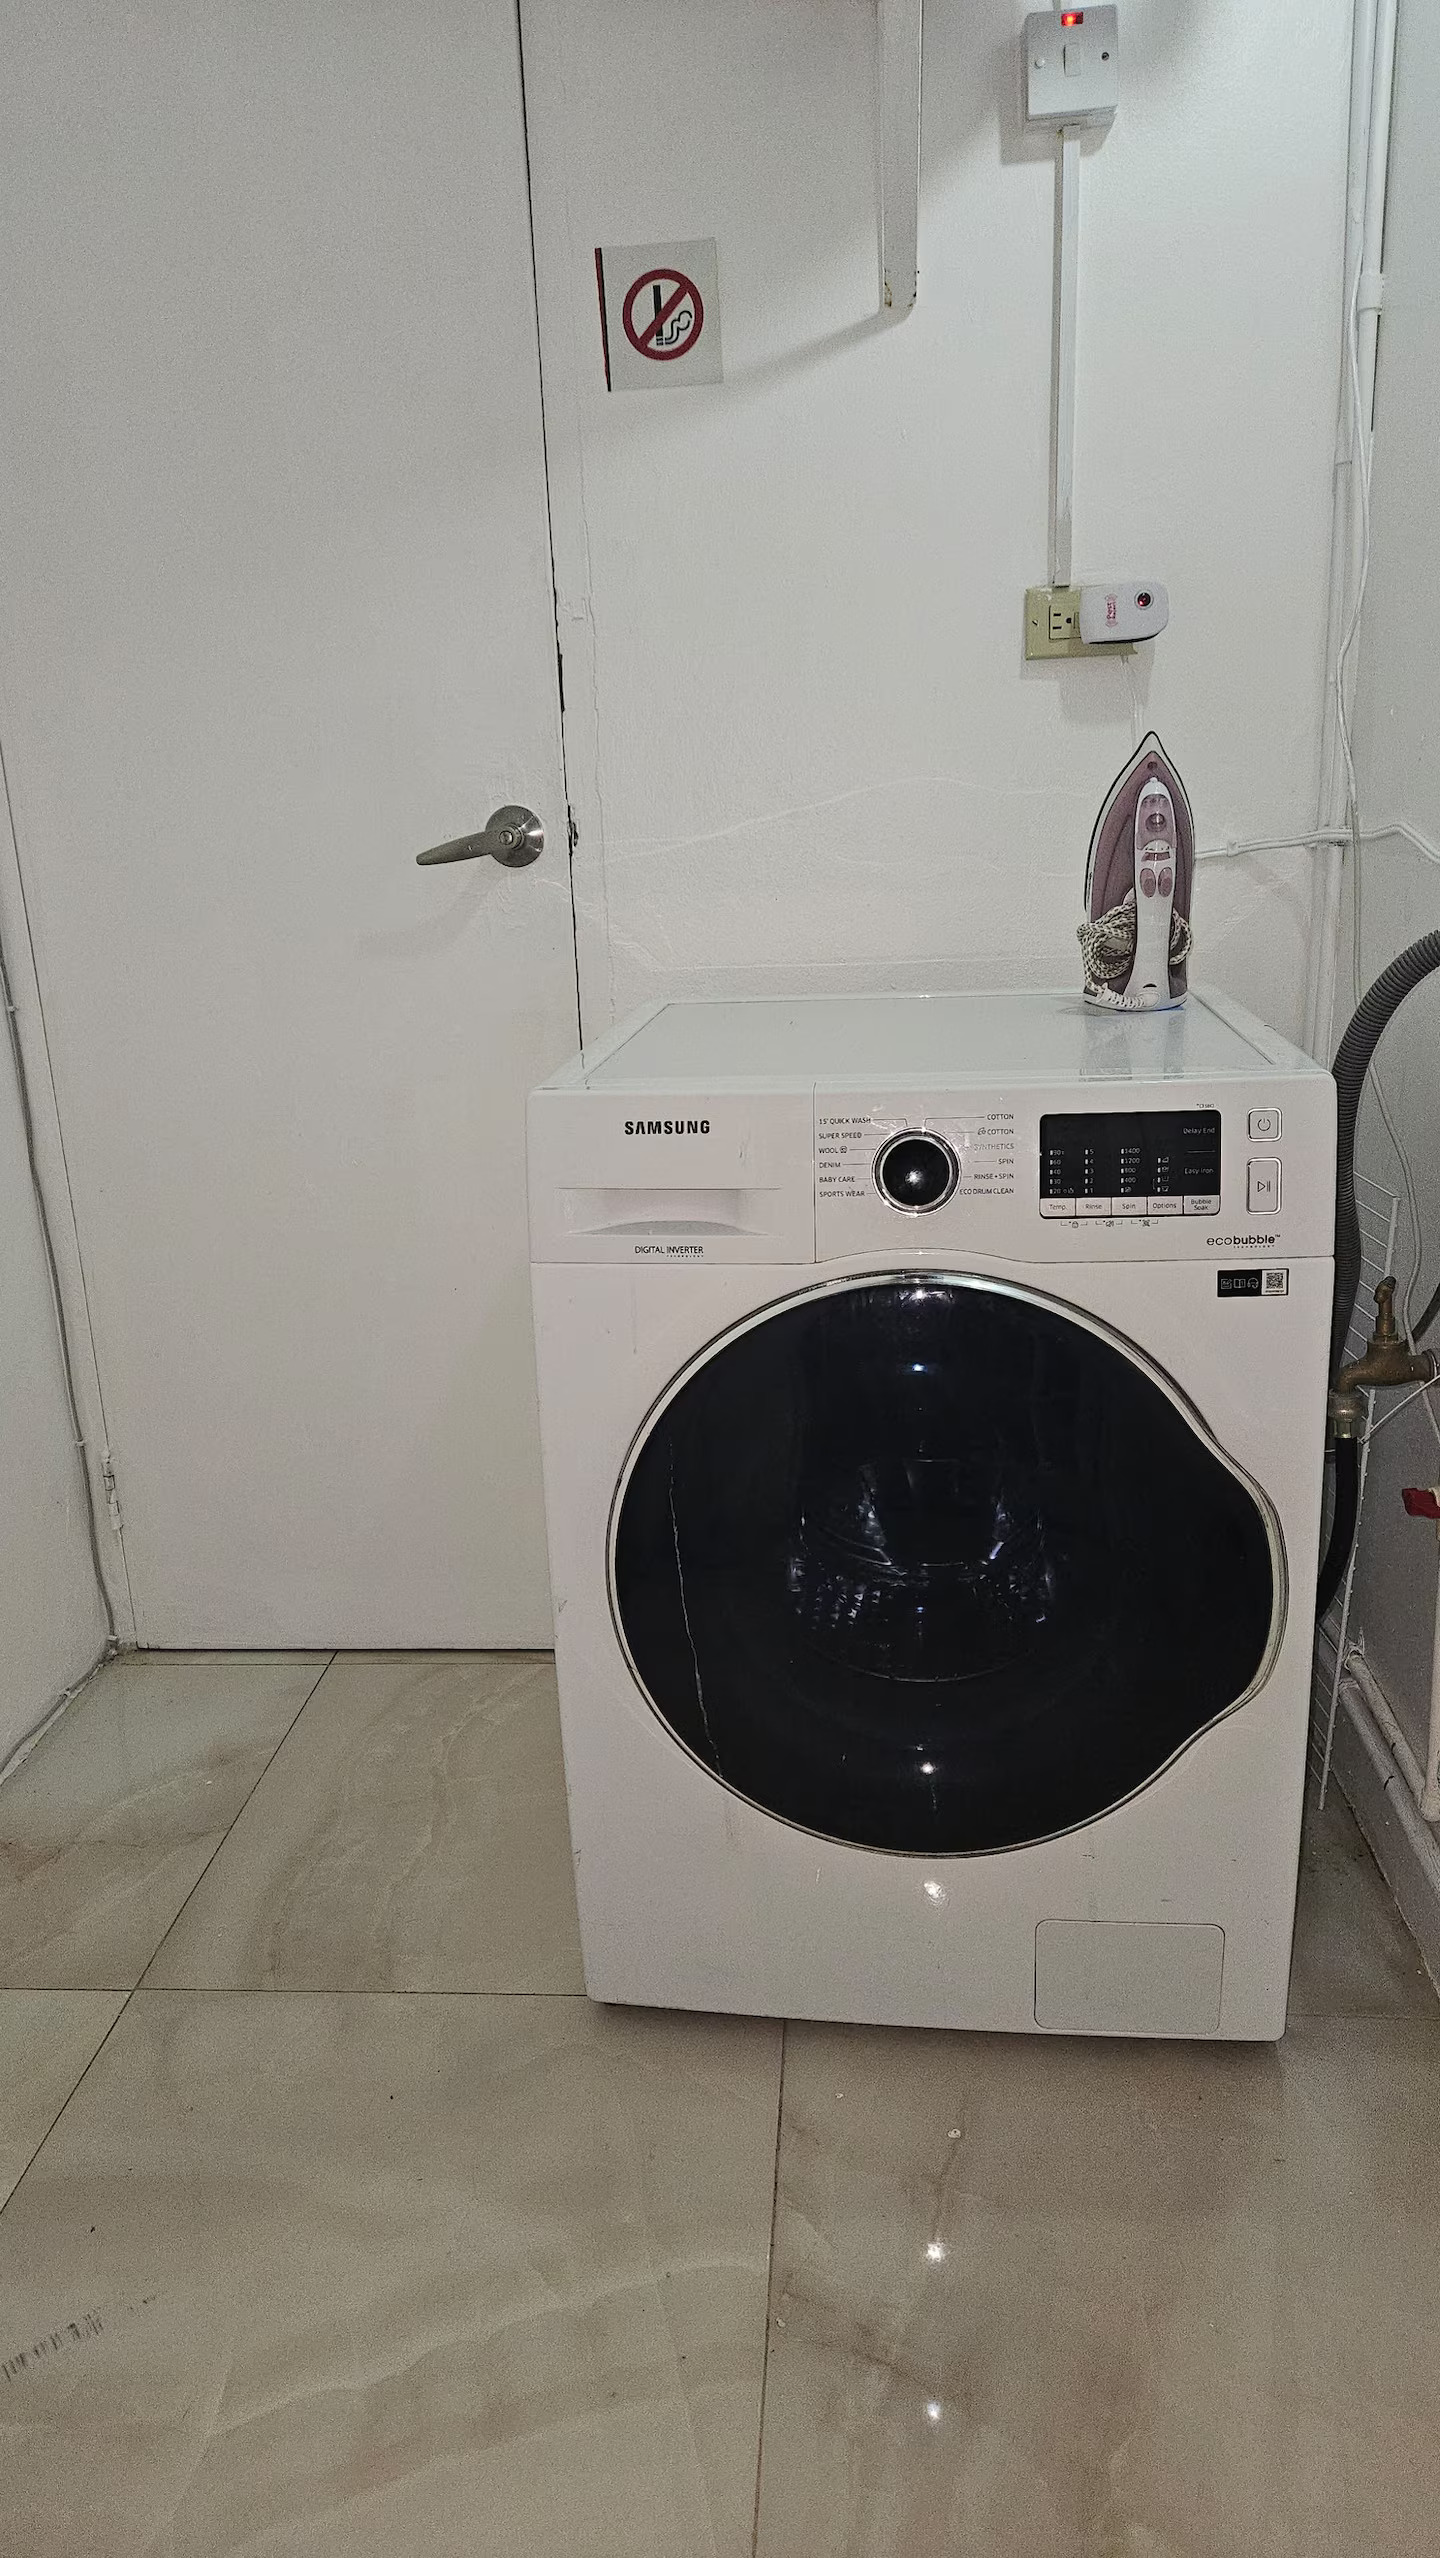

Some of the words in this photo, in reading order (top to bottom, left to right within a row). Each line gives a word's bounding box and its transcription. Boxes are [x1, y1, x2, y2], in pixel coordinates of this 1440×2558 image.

[830, 1117, 849, 1125] QUICK
[987, 1113, 1014, 1121] COTTON
[624, 1120, 710, 1135] SAMSUNG
[1183, 1127, 1201, 1136] Delay
[819, 1132, 840, 1140] SUPER
[841, 1131, 862, 1139] SPEED
[987, 1128, 1014, 1136] COTTON
[974, 1142, 1014, 1151] SYNTHETICS
[819, 1161, 841, 1169] DENIM
[838, 1175, 856, 1183] CARE
[972, 1187, 992, 1195] DRUM
[992, 1187, 1014, 1195] CLEAN
[1122, 1202, 1136, 1210] Spin
[1152, 1202, 1177, 1210] Options
[634, 1245, 665, 1254] DIGITAL
[666, 1245, 704, 1254] INVERTER
